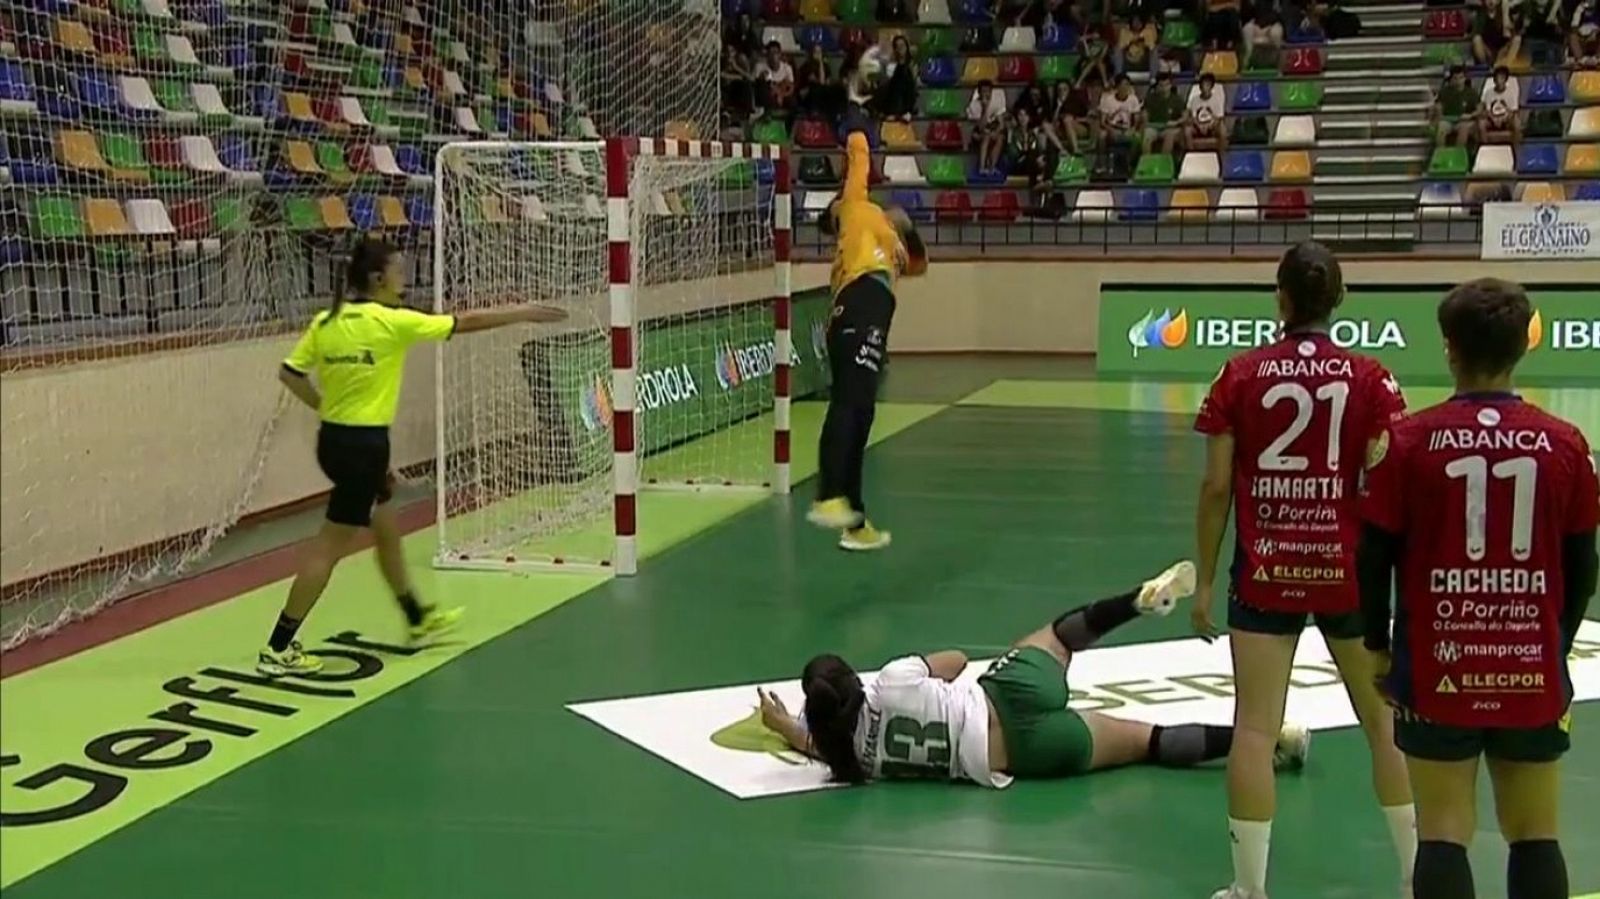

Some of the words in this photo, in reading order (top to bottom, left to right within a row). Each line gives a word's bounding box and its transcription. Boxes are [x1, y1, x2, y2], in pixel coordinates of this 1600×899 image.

[1501, 229, 1516, 247] EL
[1195, 318, 1406, 348] IBEROLA
[1257, 381, 1350, 471] 21
[1258, 503, 1272, 519] O
[1445, 455, 1537, 561] 11
[1430, 568, 1546, 595] CACHEDA
[1436, 600, 1454, 618] O
[1461, 599, 1539, 618] Porriño
[1462, 673, 1545, 687] ELECPOR
